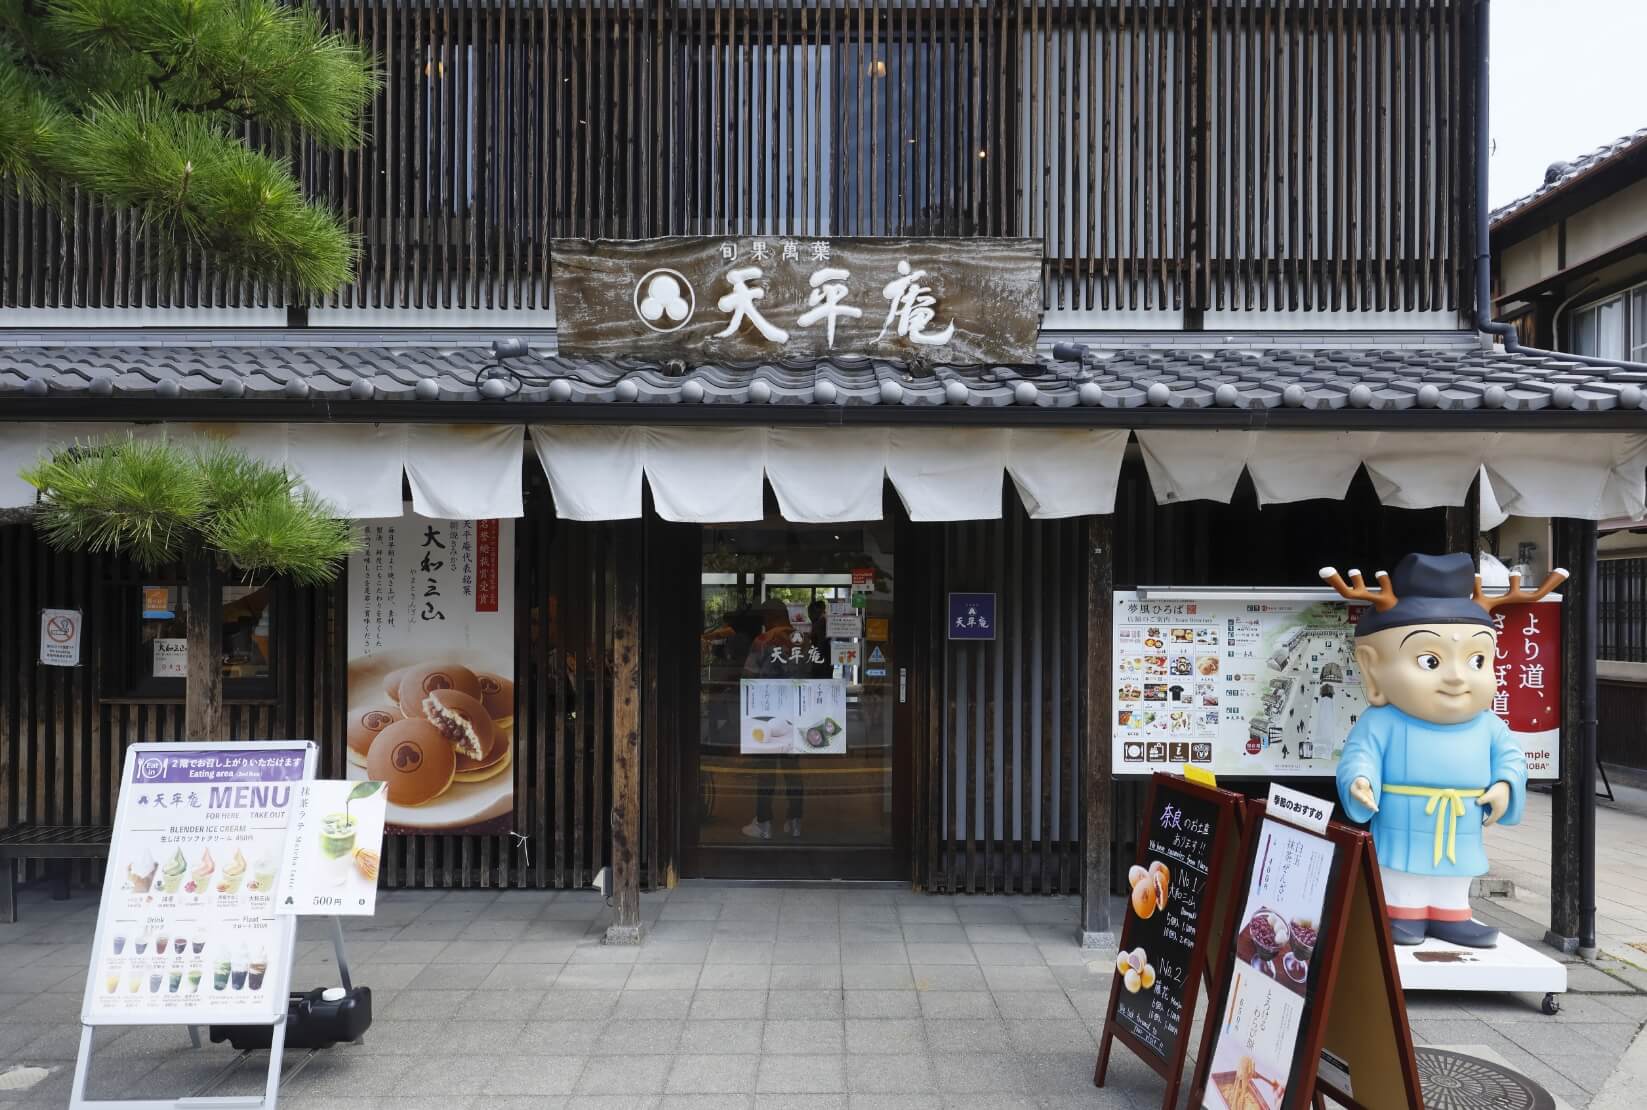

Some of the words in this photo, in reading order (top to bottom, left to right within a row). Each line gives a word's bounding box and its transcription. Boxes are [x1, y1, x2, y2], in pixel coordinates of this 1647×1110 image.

[720, 241, 831, 261] 旬果萬葉
[712, 260, 955, 349] 天平庵
[420, 524, 446, 621] 大和三山
[1127, 603, 1184, 615] 夢風ひろば
[956, 615, 990, 629] 天平庵
[769, 646, 825, 665] 天平庵
[1519, 613, 1545, 698] より道、
[1524, 749, 1550, 762] mple
[189, 769, 214, 780] Eating
[215, 770, 234, 778] area
[152, 791, 202, 809] 天平庵
[208, 785, 291, 809] MENU
[206, 812, 220, 820] FOR
[250, 811, 268, 819] TAKE
[1273, 794, 1324, 821] 季節のおすすめ
[169, 825, 205, 834] BLENDER
[205, 825, 218, 833] ICE
[218, 825, 247, 833] CREAM
[312, 895, 342, 906] 500円
[1168, 880, 1196, 909] 大和三山
